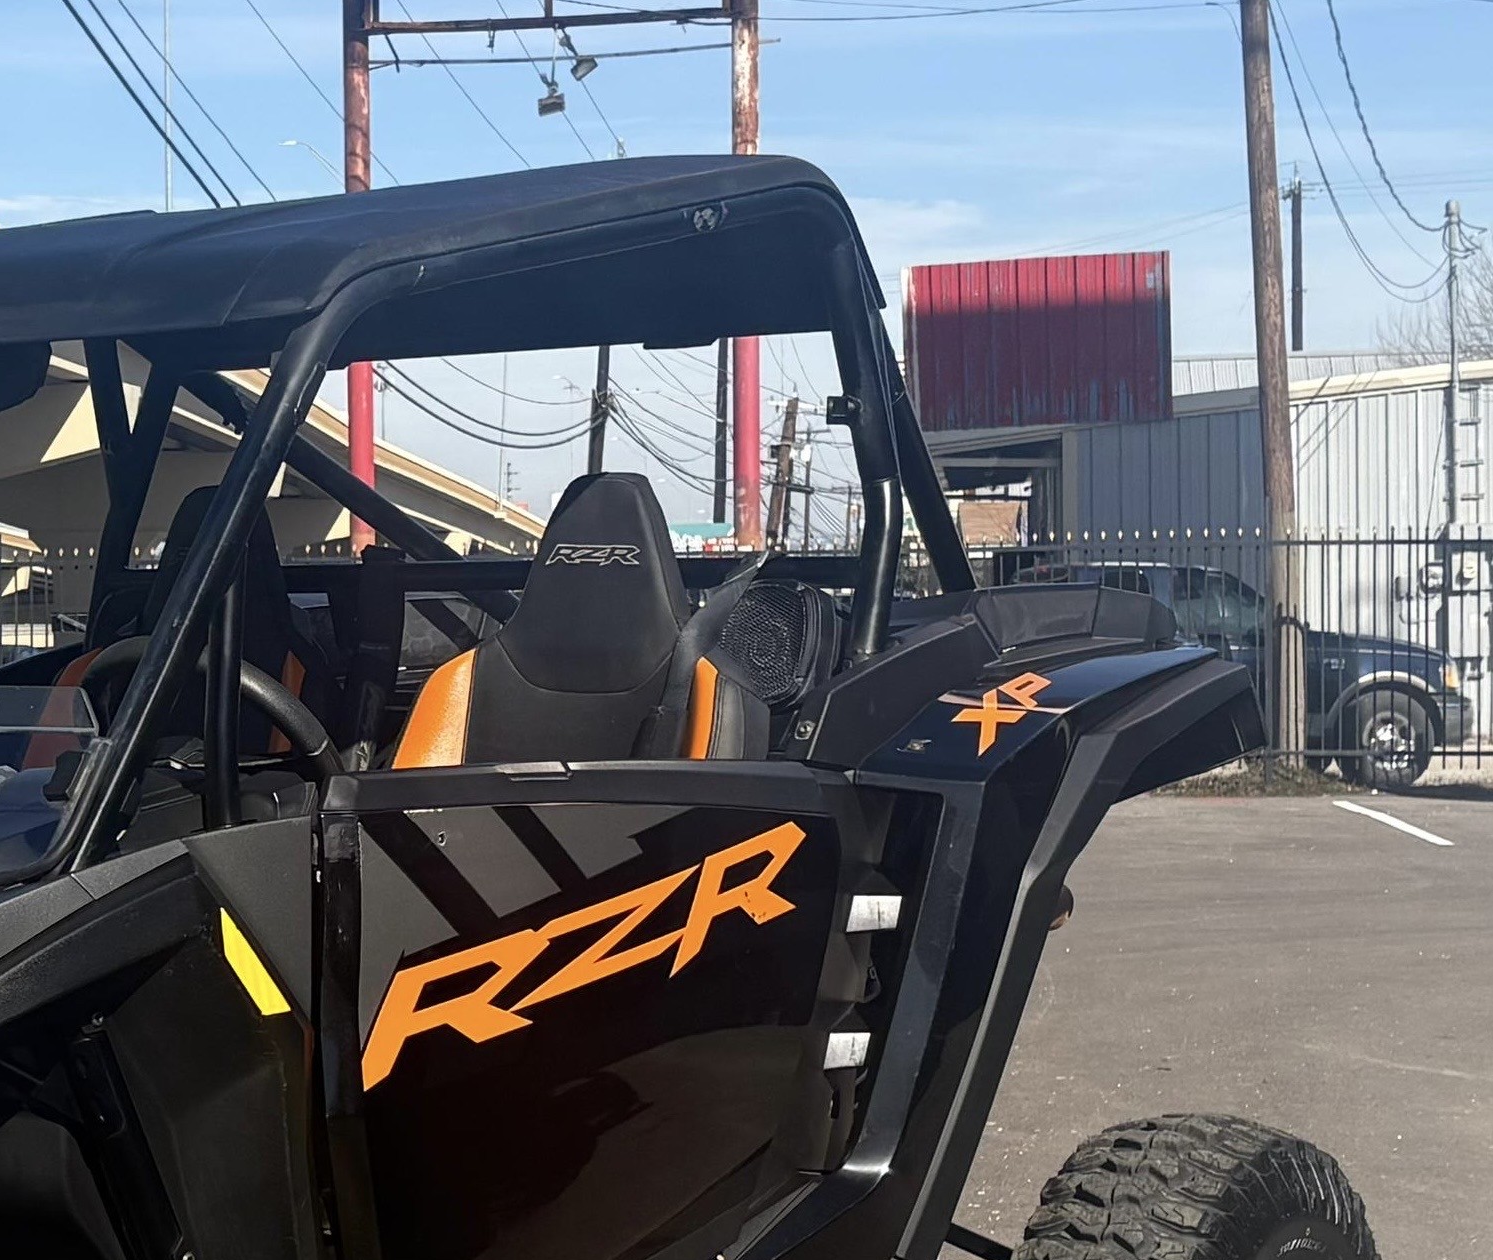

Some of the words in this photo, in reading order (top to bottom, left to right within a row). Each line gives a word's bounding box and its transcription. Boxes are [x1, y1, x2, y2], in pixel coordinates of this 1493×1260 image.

[545, 544, 641, 567] RZR
[951, 671, 1053, 757] XP
[361, 821, 806, 1092] RZR
